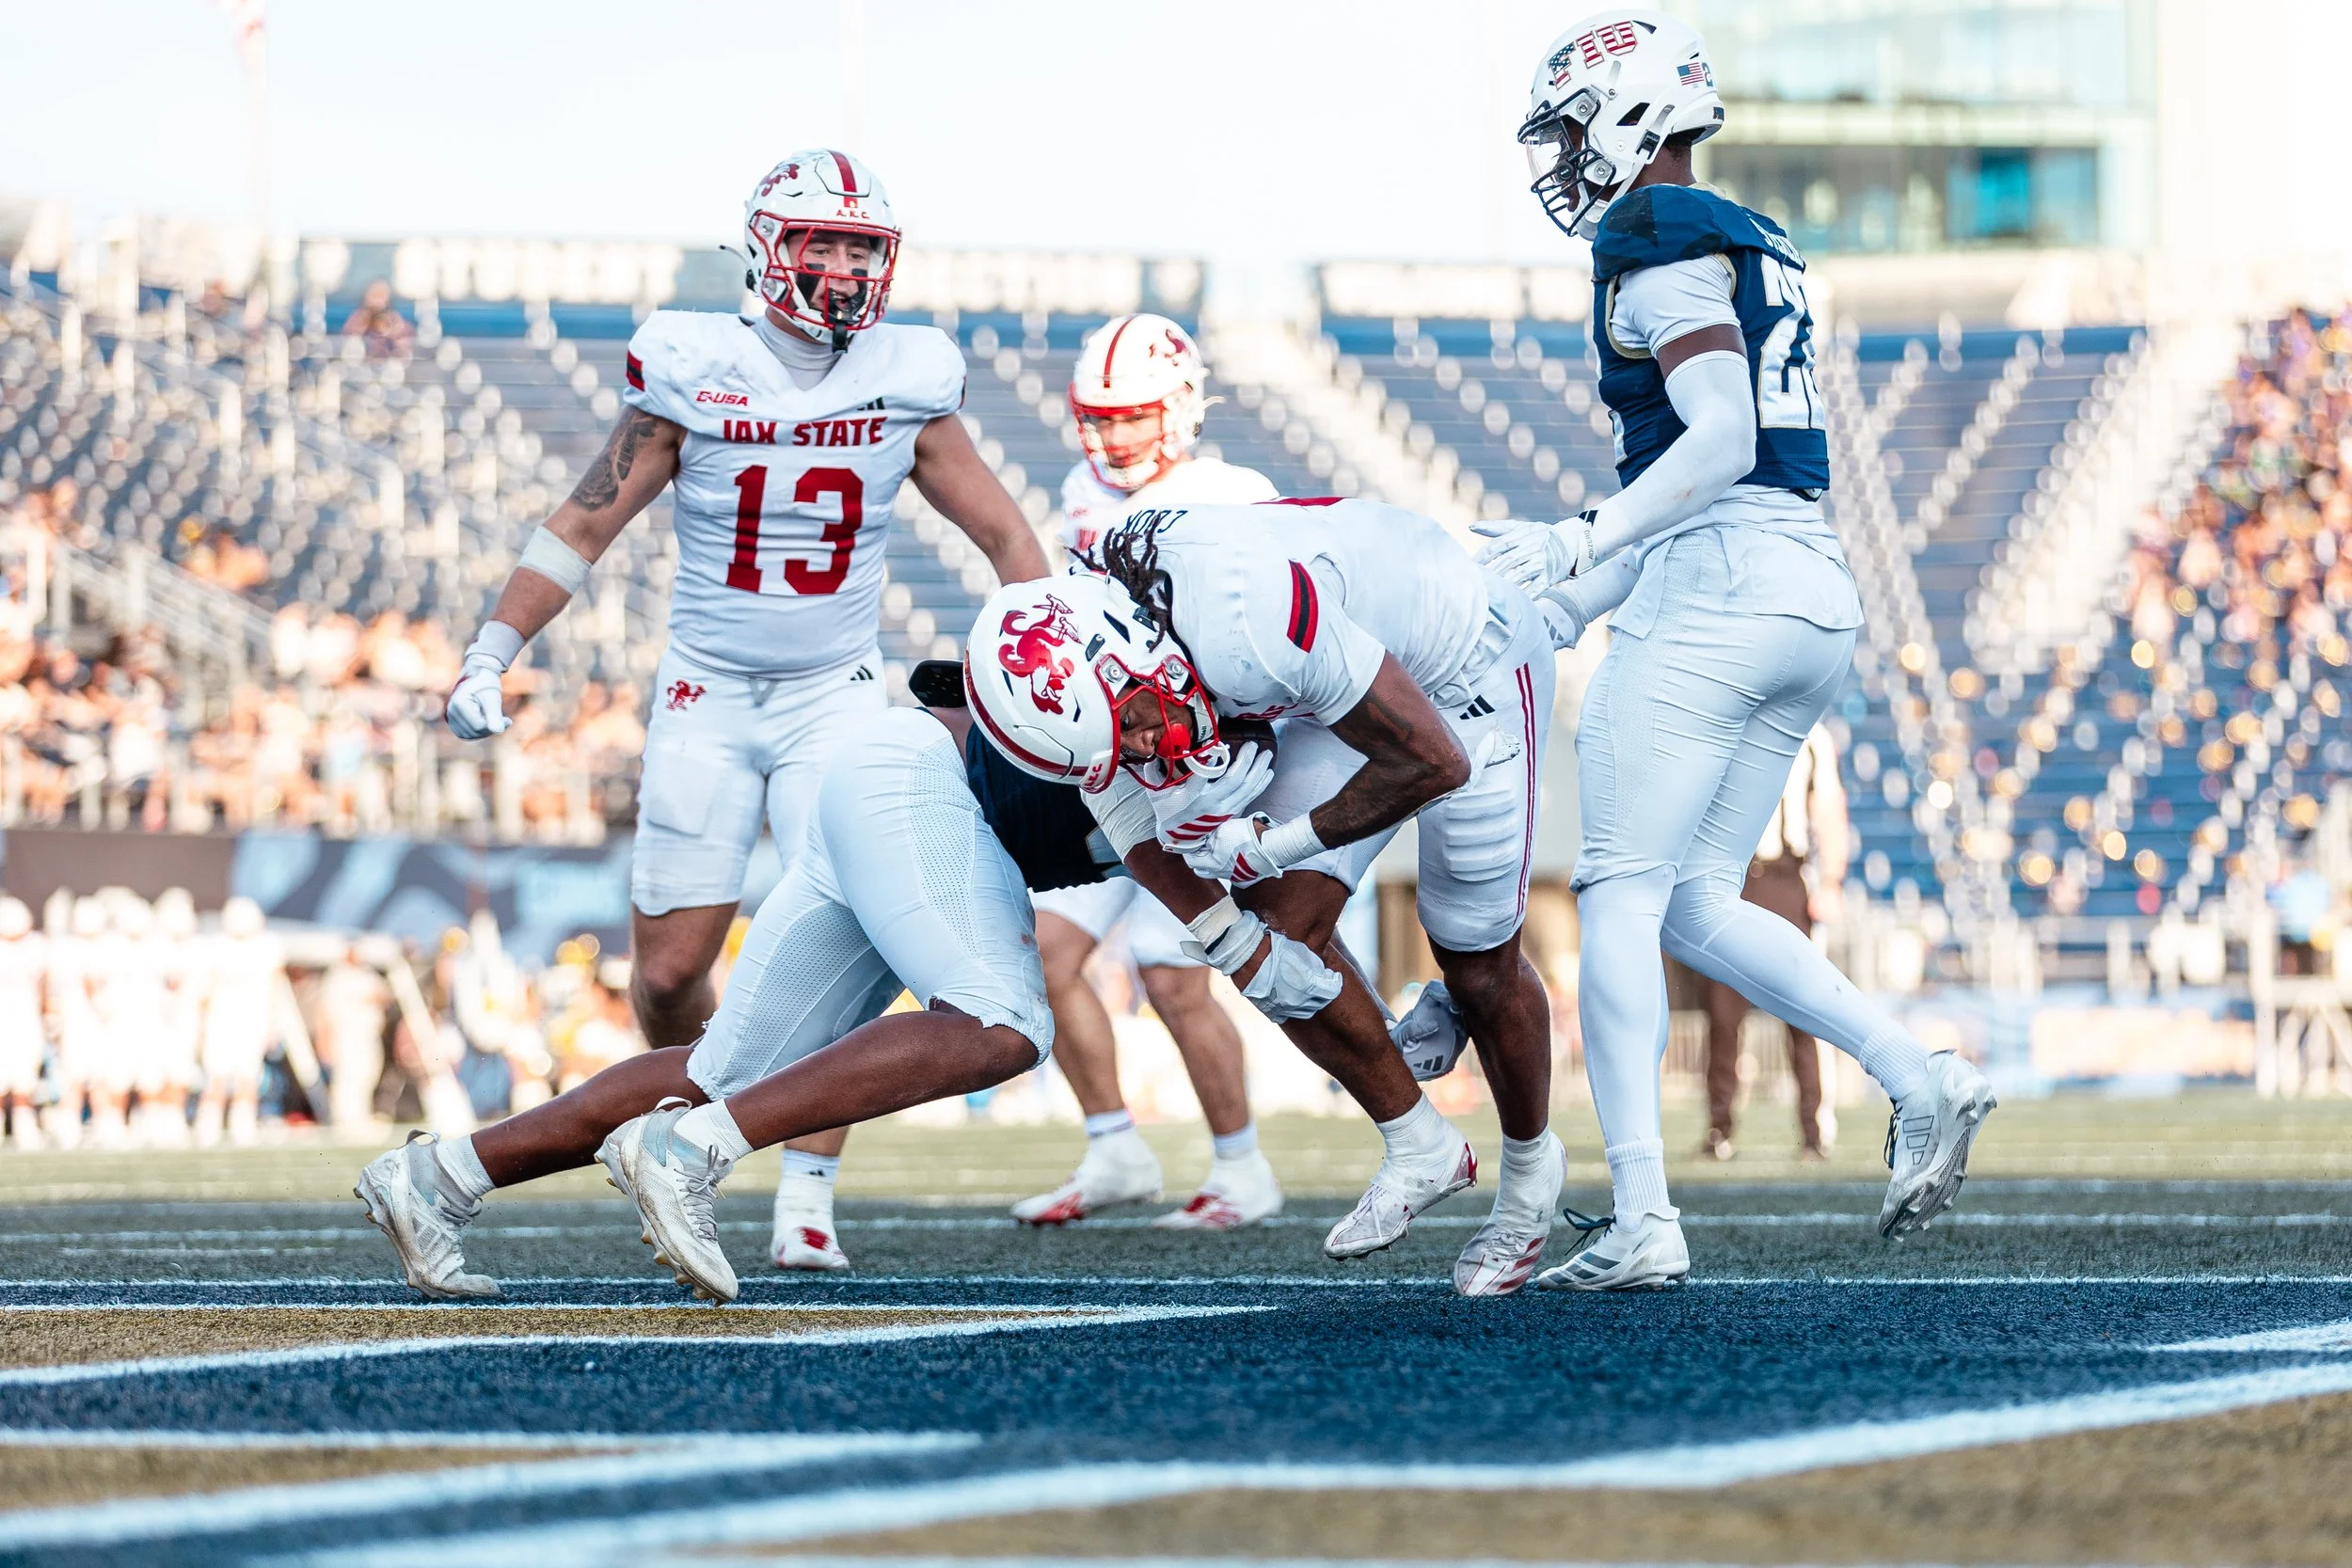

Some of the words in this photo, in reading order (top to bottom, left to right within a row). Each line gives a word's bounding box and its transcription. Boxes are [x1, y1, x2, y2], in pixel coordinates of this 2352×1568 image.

[1548, 20, 1638, 91] FIU
[792, 417, 888, 447] STATE
[726, 464, 864, 594] 13
